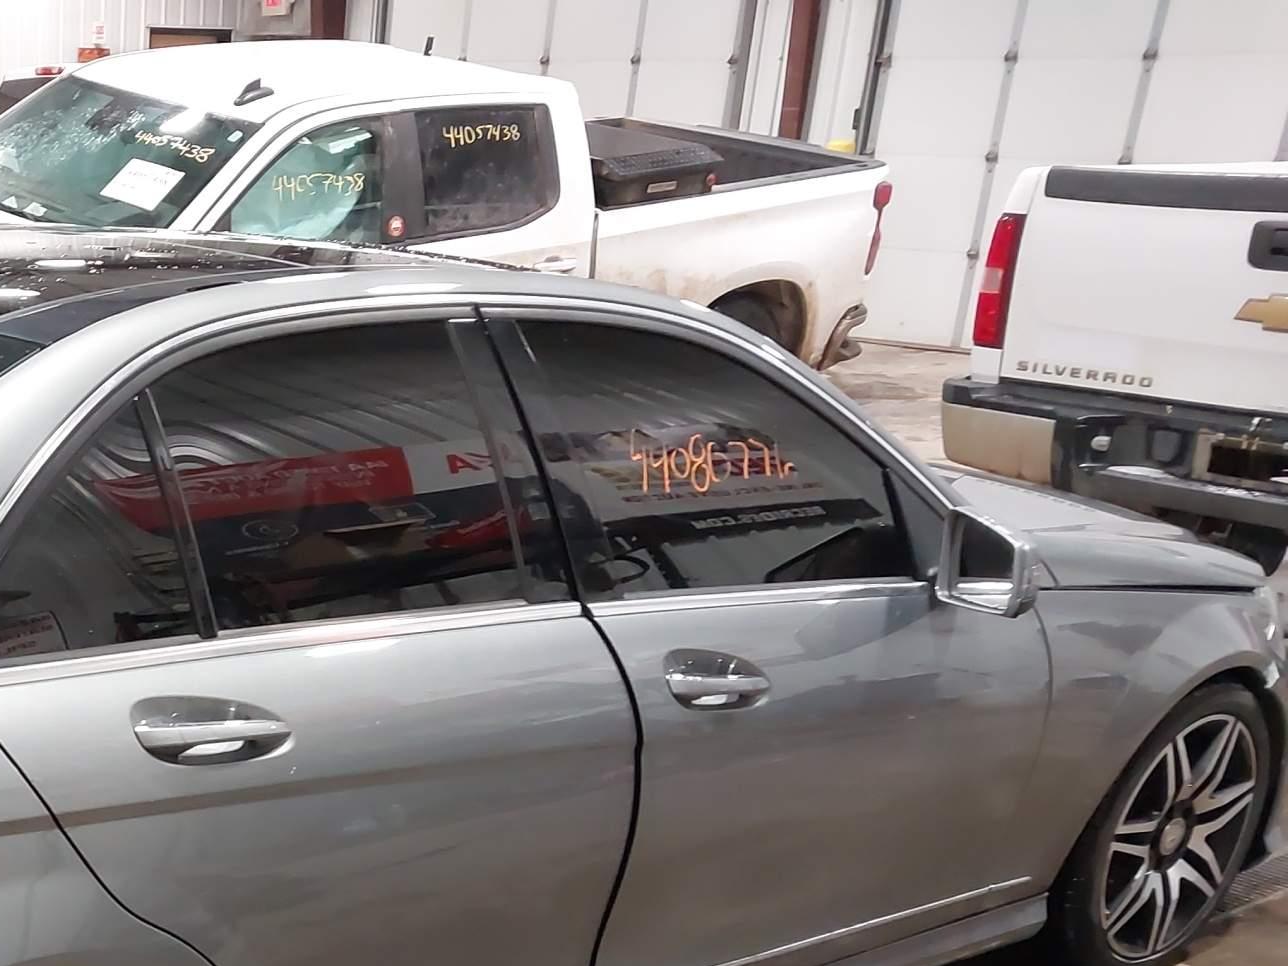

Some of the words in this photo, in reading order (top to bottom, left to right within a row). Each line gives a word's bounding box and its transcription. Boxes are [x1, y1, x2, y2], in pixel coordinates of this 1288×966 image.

[134, 130, 216, 163] 44057438
[442, 124, 521, 148] 44057438
[271, 172, 366, 201] 44057438
[1016, 360, 1154, 388] SILVERADO
